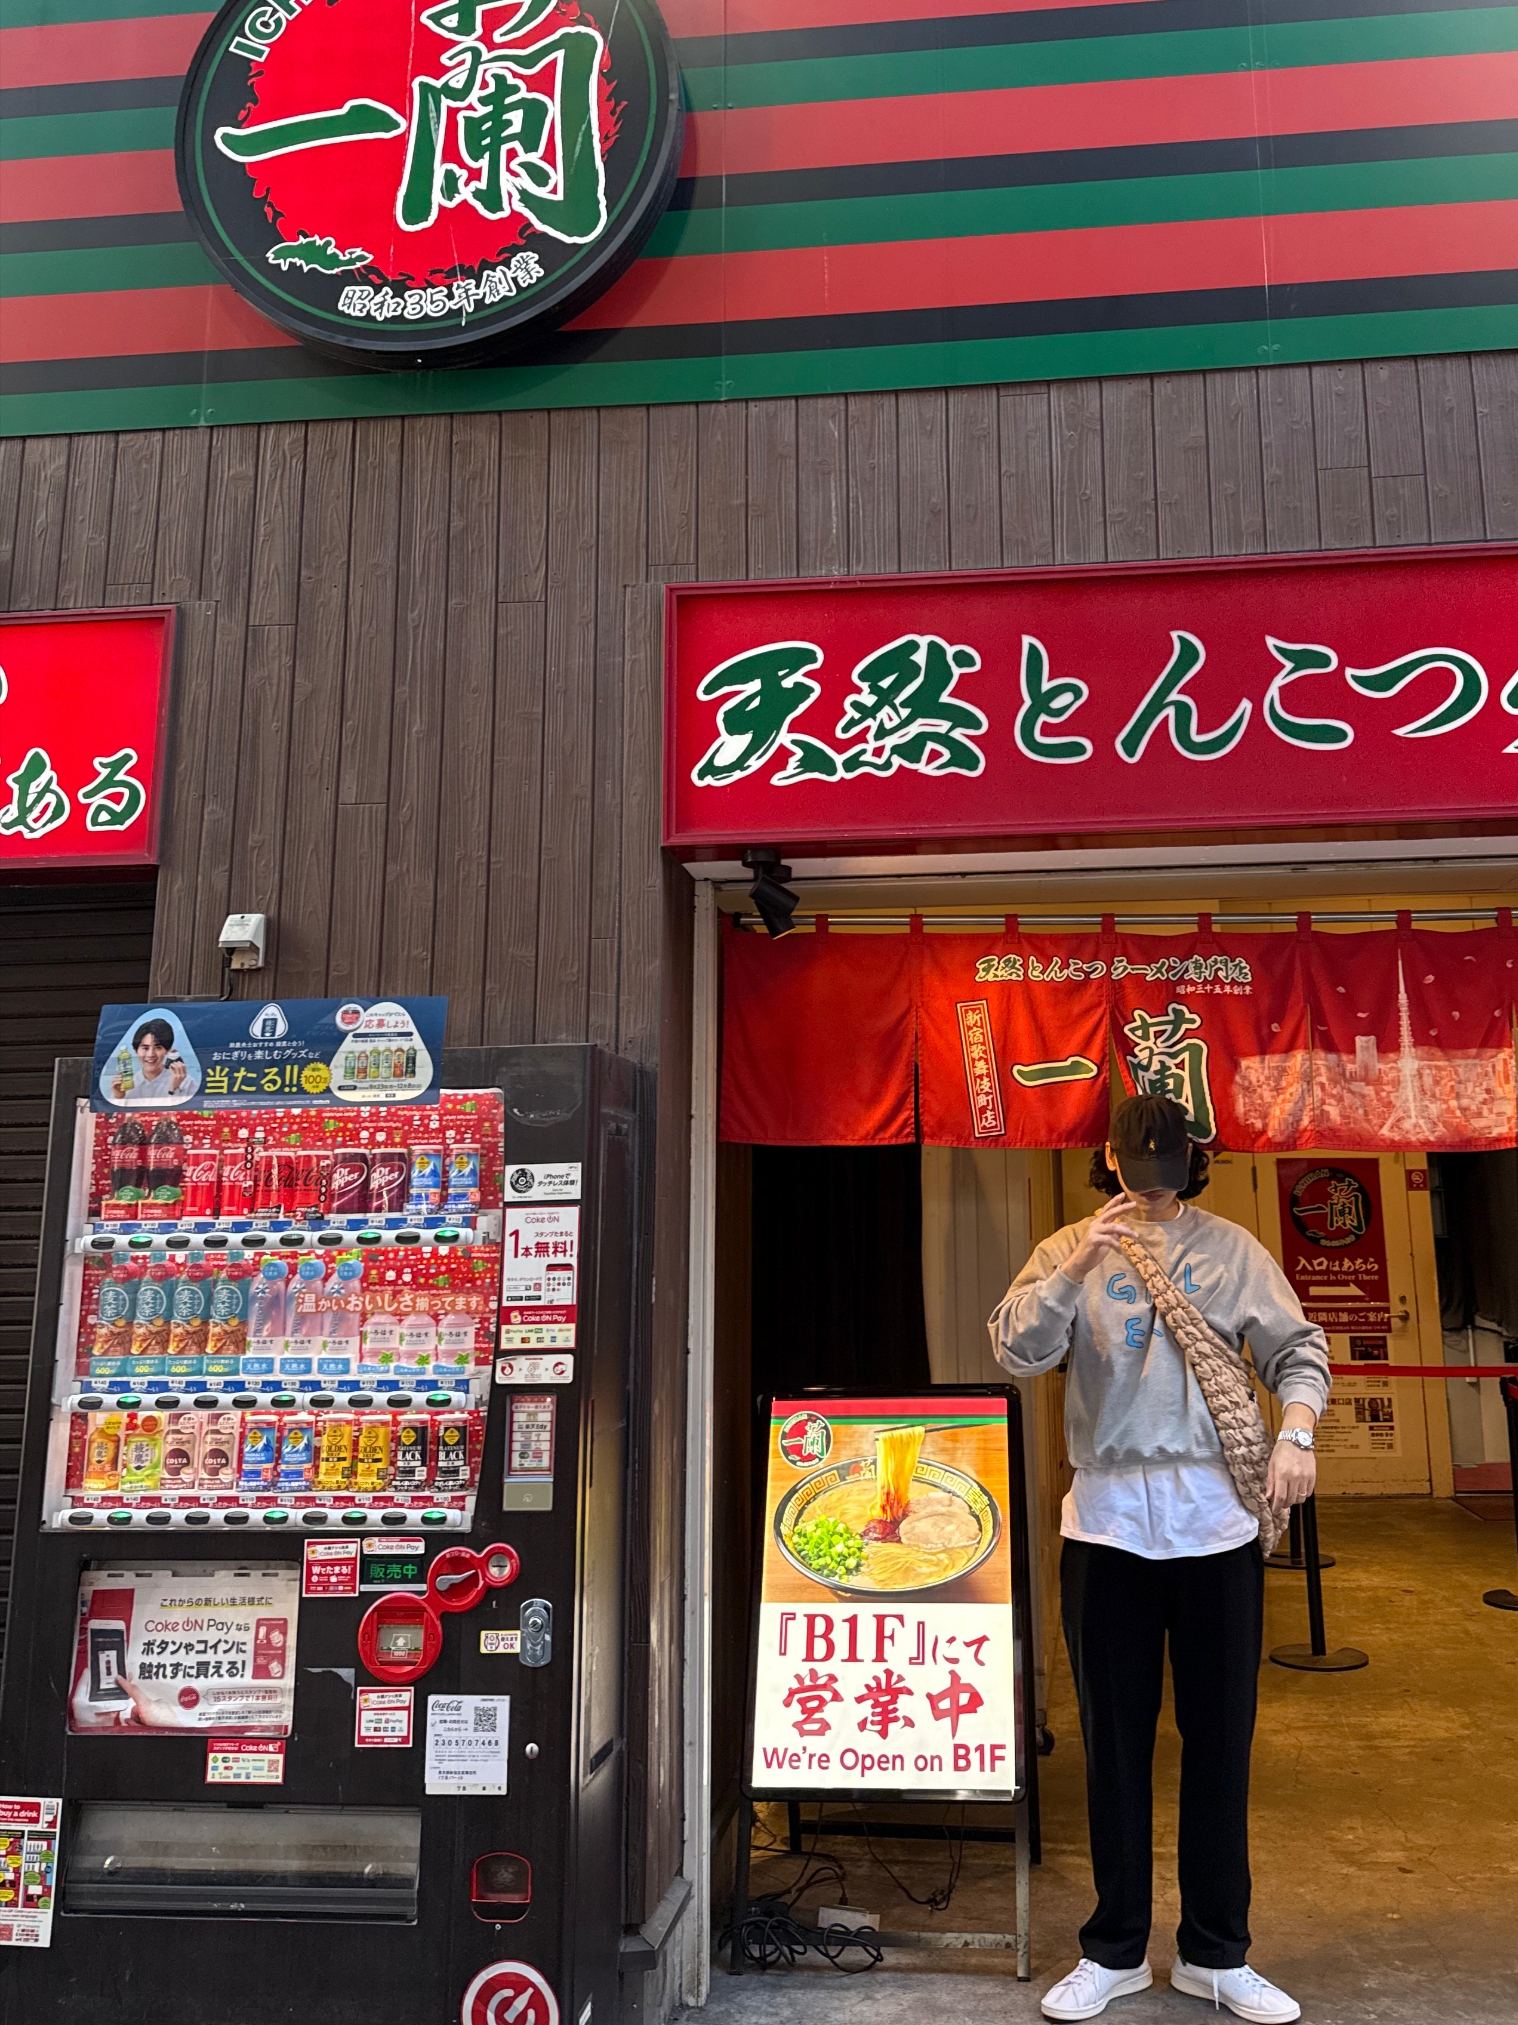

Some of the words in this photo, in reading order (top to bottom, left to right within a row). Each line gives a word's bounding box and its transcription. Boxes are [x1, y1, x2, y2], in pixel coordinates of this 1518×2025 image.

[338, 252, 545, 325] 昭和35年創業
[1175, 984, 1253, 995] 昭和三十五年創業
[364, 1018, 409, 1029] 応募しよう!
[212, 1049, 321, 1060] おにぎりを楽しむグッズなど
[964, 1009, 998, 1130] 新宿歌舞伎町店
[205, 1065, 299, 1094] 当たる!!
[1293, 1169, 1330, 1196] ICHIRAN
[1293, 1177, 1366, 1235] 一蘭
[525, 1216, 546, 1224] Coke
[509, 1229, 574, 1259] 1本無料!
[1295, 1256, 1379, 1272] 入口はあちら
[1295, 1273, 1328, 1281] Entrance
[104, 1291, 117, 1316] 麦茶
[142, 1290, 155, 1316] 麦茶
[178, 1289, 193, 1316] 麦茶
[216, 1289, 231, 1316] 麦茶
[297, 1293, 484, 1313] 温かいおいしさ揃ってます。
[553, 1314, 566, 1322] Pay
[246, 1362, 268, 1370] 天然水
[782, 1420, 826, 1458] 一蘭
[438, 1451, 465, 1460] BLACK
[311, 1565, 352, 1574] Wでたまる!
[369, 1563, 417, 1578] 販売中
[160, 1597, 273, 1607] これからの新しい生活様式に
[144, 1619, 179, 1633] Coke
[206, 1618, 234, 1635] Pay
[235, 1622, 251, 1632] なら
[141, 1638, 247, 1656] ボタンやコインに
[503, 1642, 515, 1650] OK
[778, 1612, 991, 1667] 『B1F』にて
[138, 1660, 246, 1680] 触れずに買える!
[782, 1667, 985, 1741] 営業中
[762, 1746, 830, 1771] We're
[839, 1747, 905, 1778] Open
[913, 1752, 943, 1772] on
[952, 1743, 1006, 1773] B1F
[19, 1810, 38, 1818] drink
